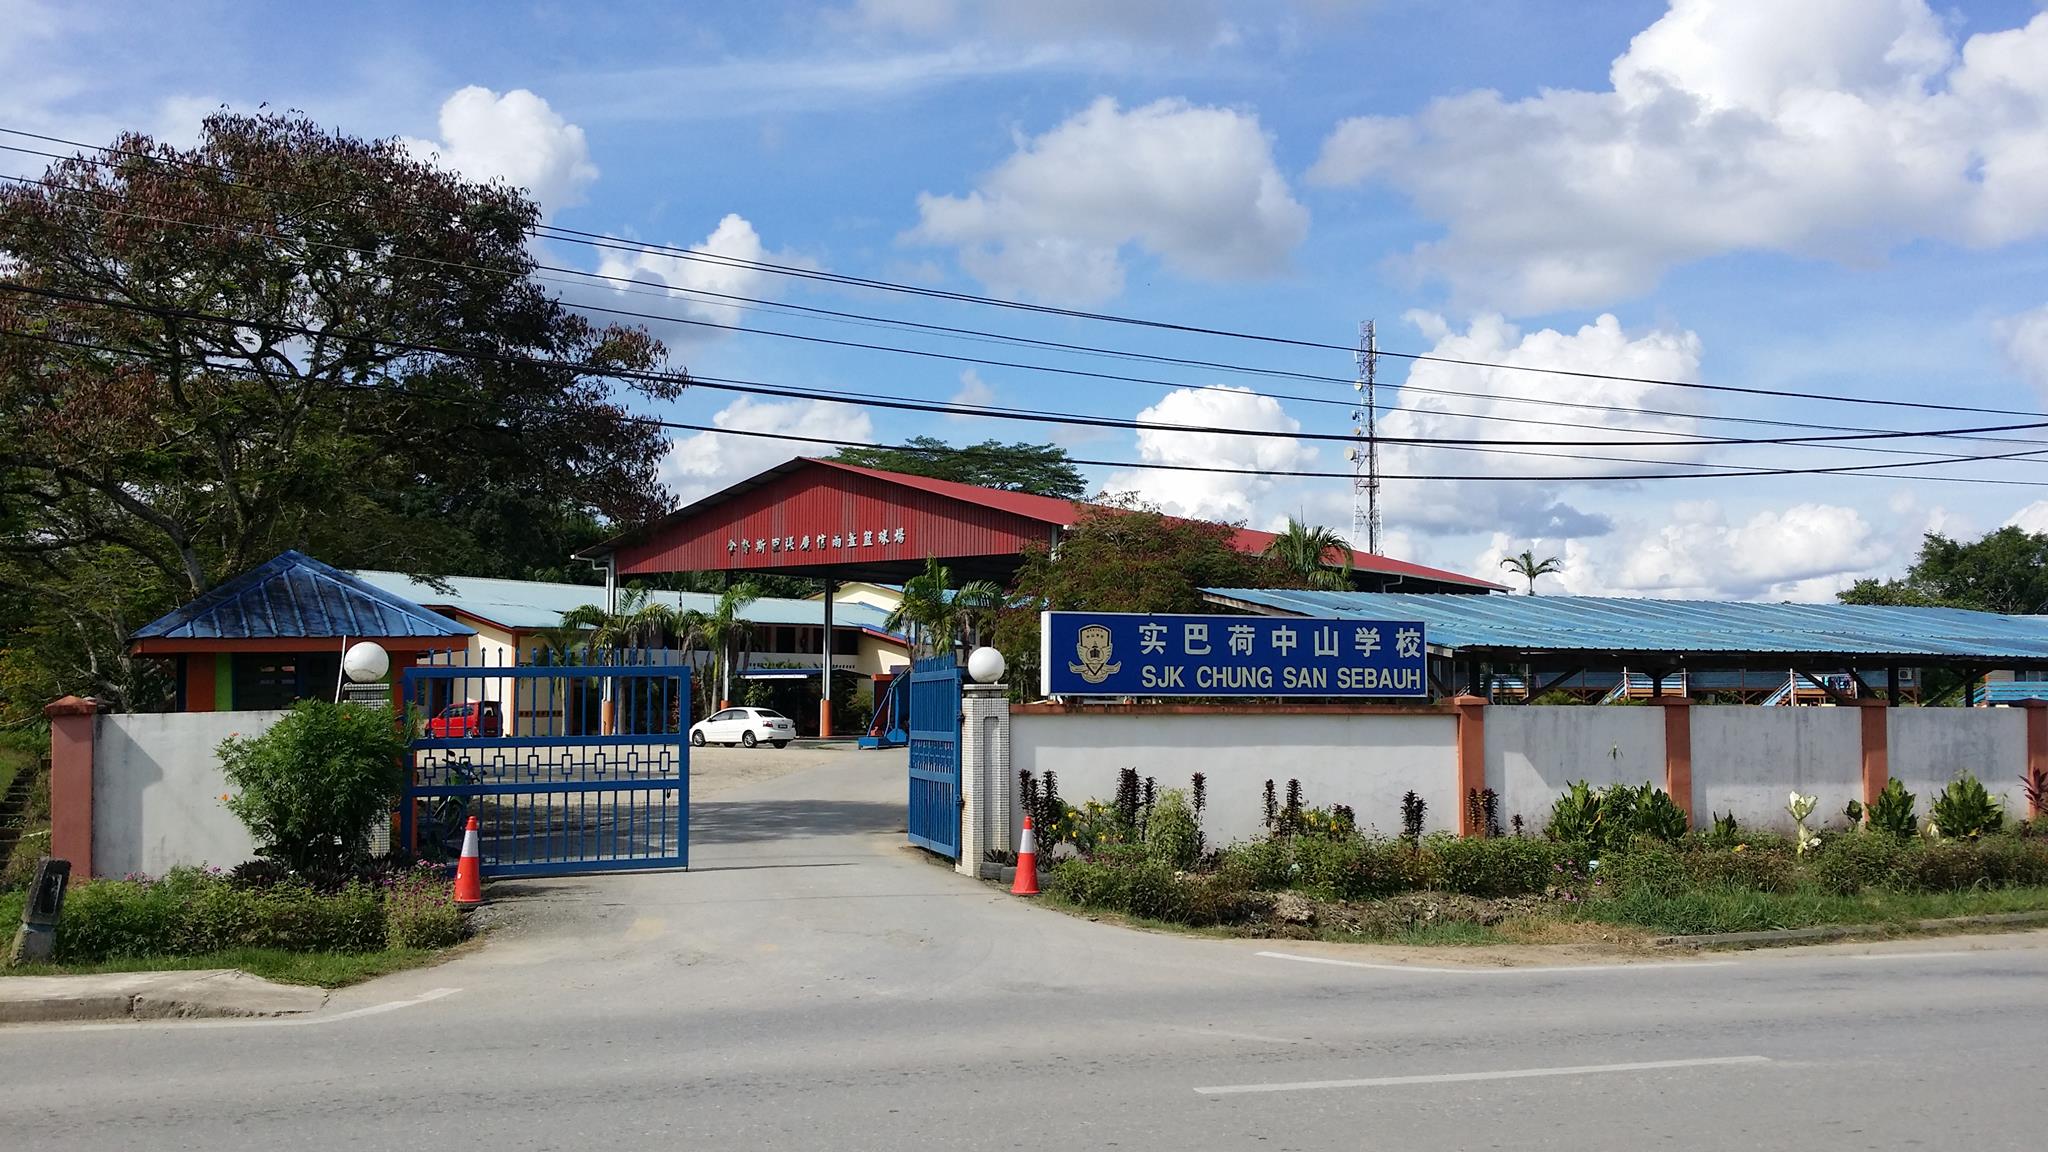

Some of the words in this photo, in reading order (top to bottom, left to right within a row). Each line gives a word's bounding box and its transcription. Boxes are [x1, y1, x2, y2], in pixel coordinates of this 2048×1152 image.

[1138, 622, 1421, 659] 实巴荷中山学校
[1141, 664, 1185, 688] SJK
[1196, 665, 1273, 689] CHUNG
[1282, 666, 1327, 689] SAN
[1337, 667, 1421, 690] SEBAUH
